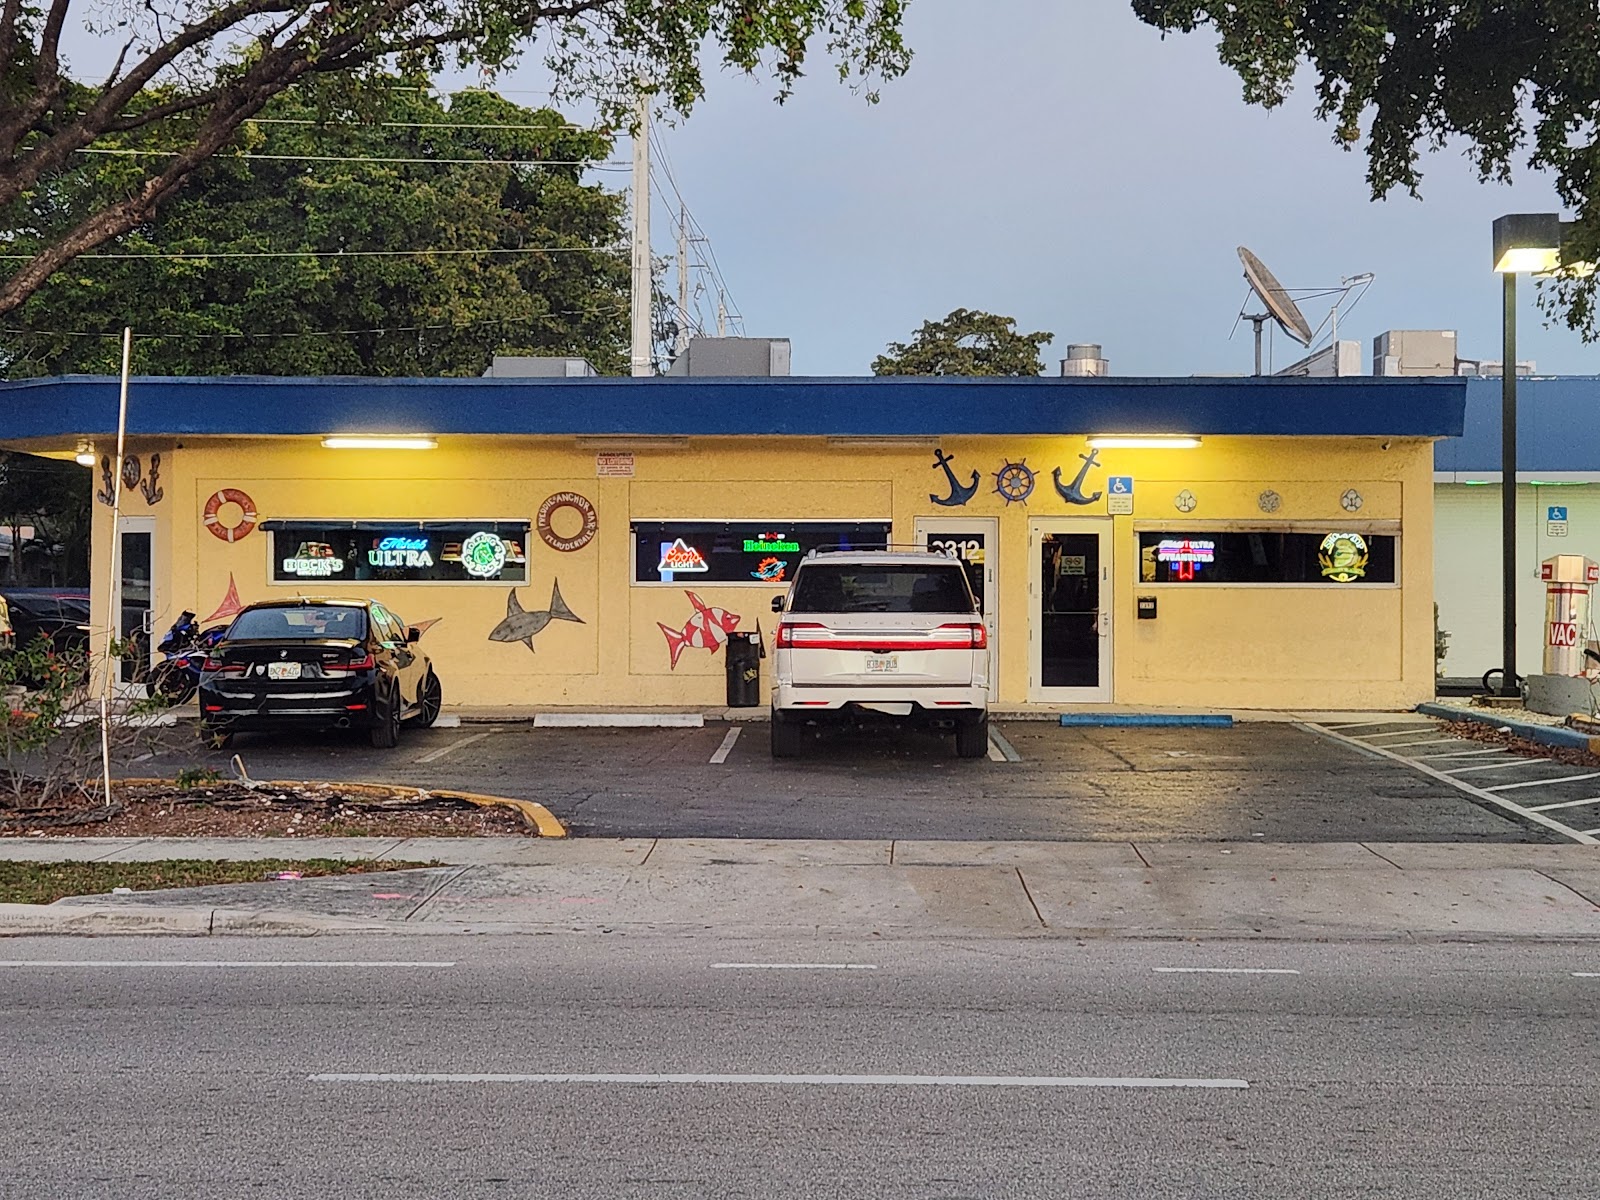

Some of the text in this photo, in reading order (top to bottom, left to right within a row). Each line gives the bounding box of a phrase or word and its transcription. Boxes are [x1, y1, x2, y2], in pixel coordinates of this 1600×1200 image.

[556, 493, 590, 511] ANCHOR
[552, 530, 595, 550] LAUDERDALE
[743, 540, 800, 552] Heineken
[368, 550, 434, 567] ULTRA
[665, 548, 702, 563] Coors
[283, 557, 344, 573] BECK'S
[1550, 623, 1576, 646] VAC
